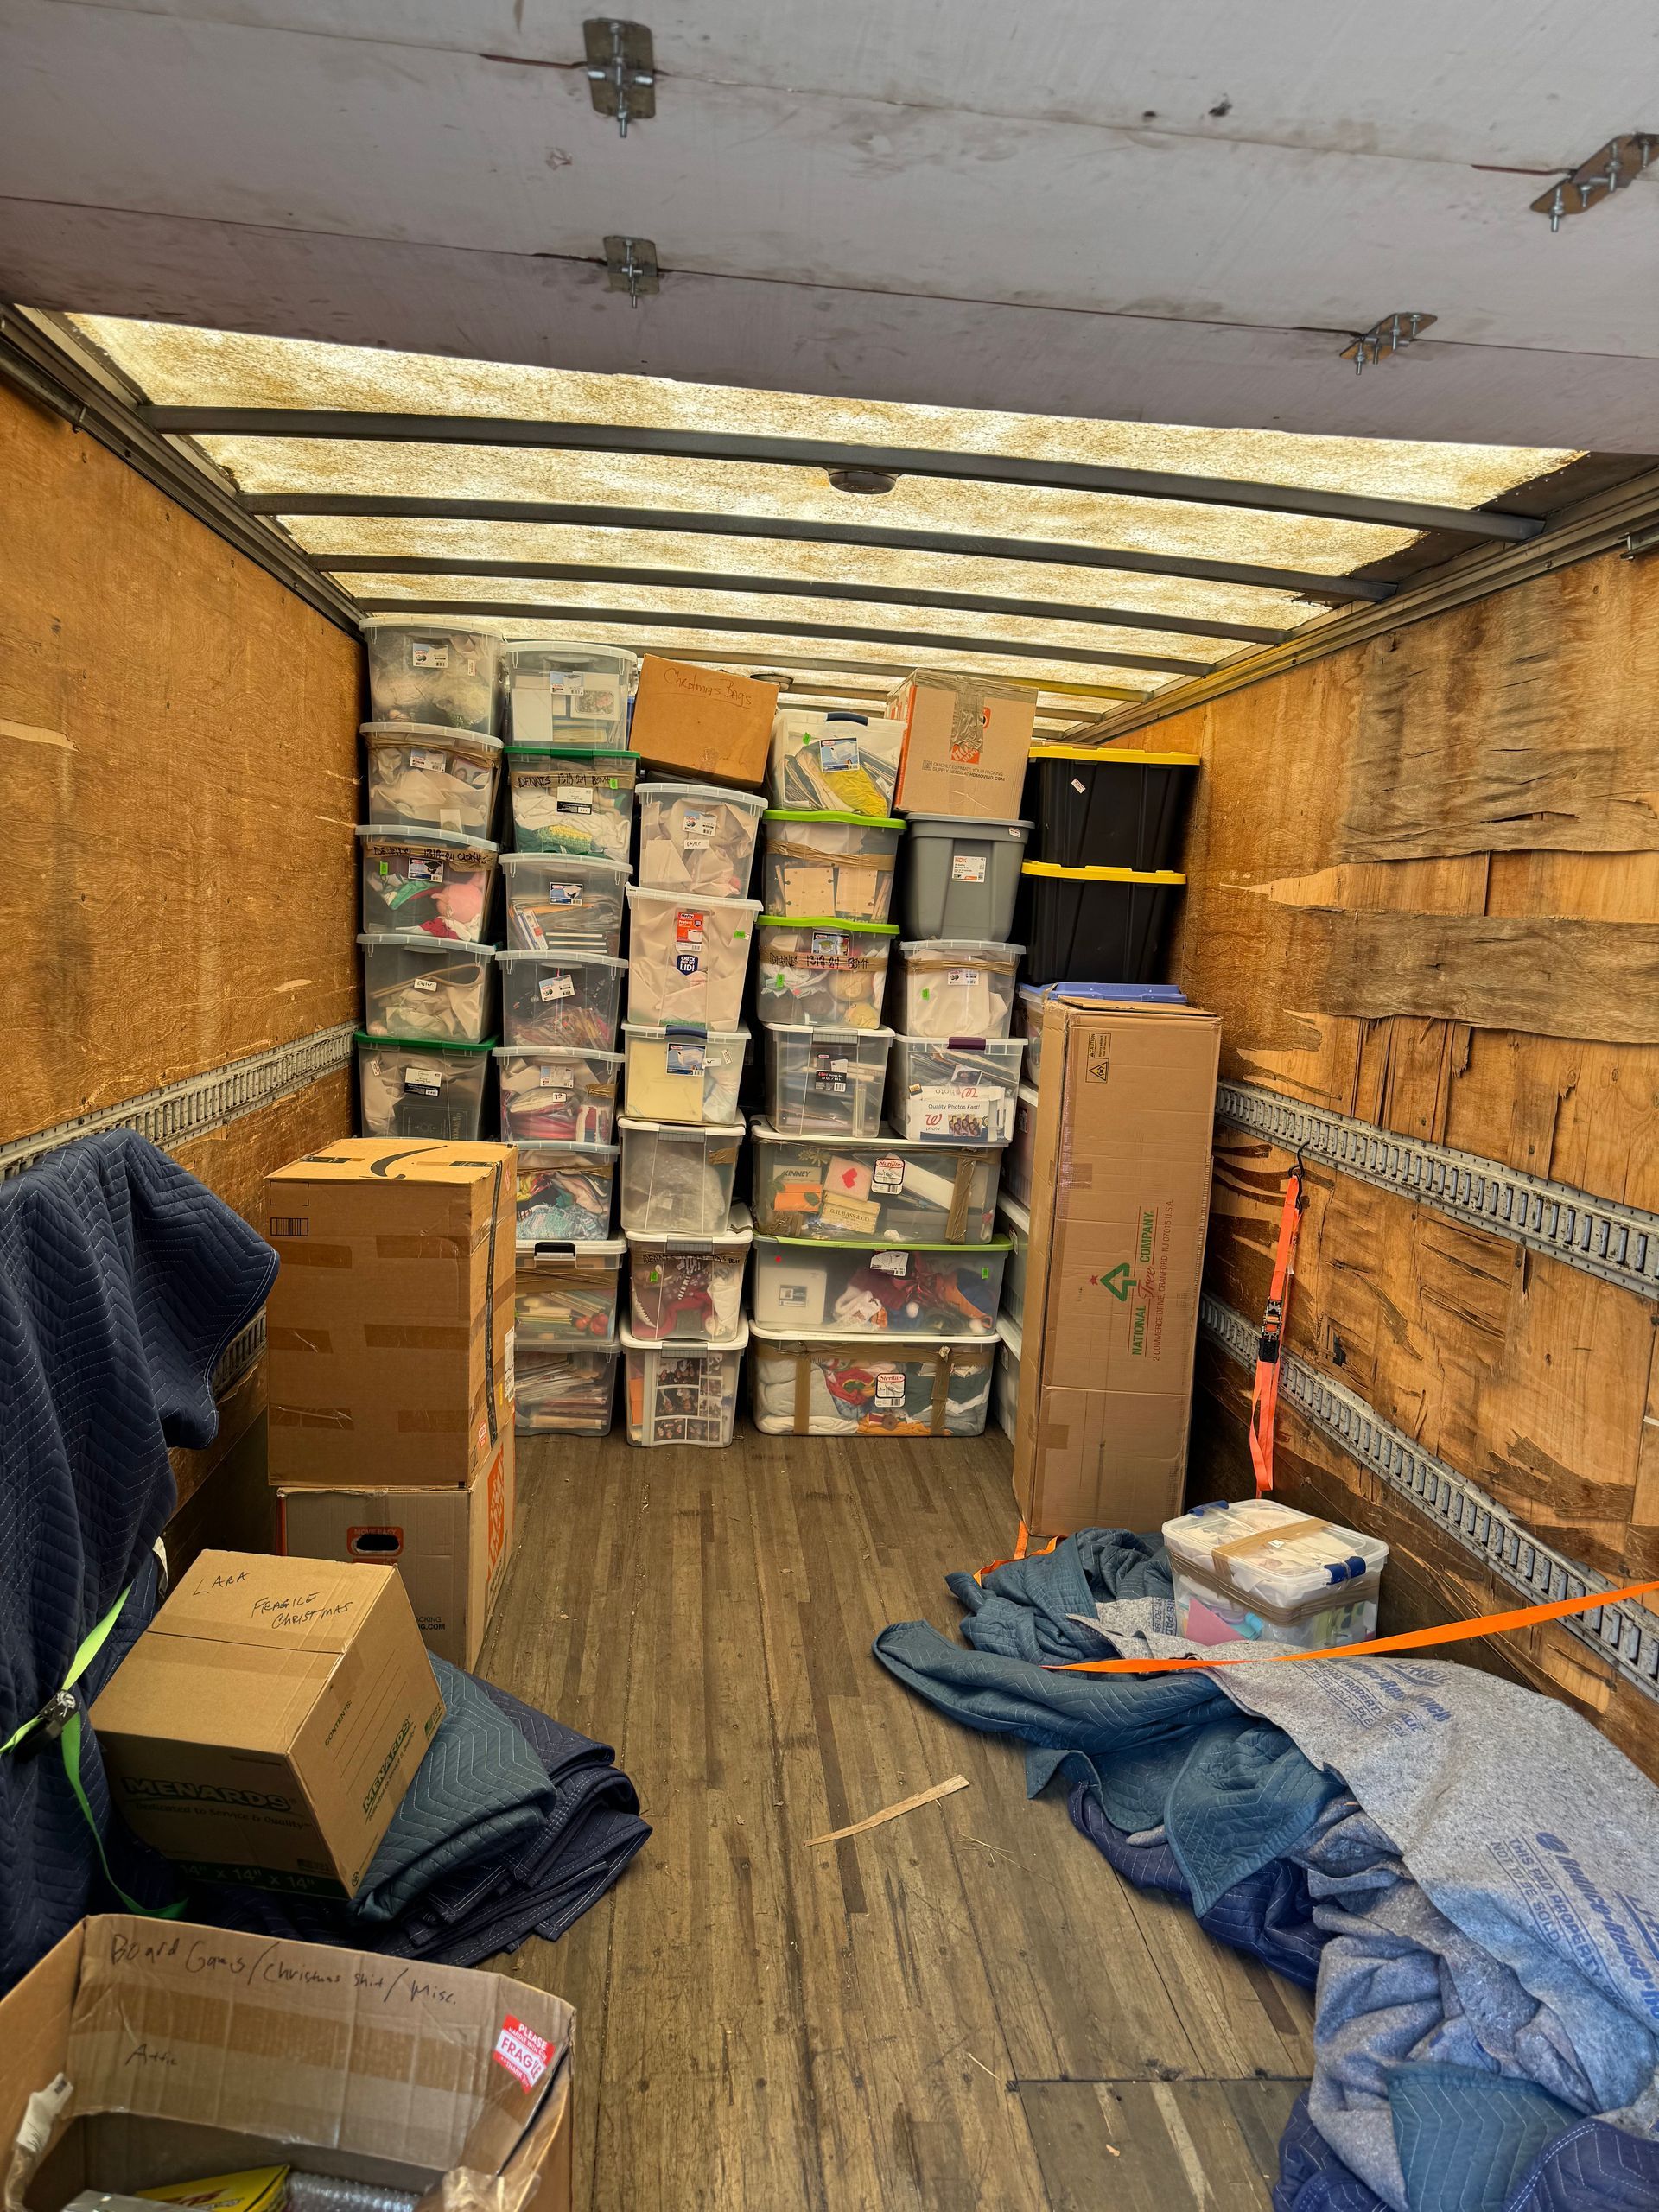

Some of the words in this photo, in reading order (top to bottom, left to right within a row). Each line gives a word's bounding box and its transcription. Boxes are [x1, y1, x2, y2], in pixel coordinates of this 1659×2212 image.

[518, 776, 551, 788] DENNIS
[783, 1169, 810, 1178] KINNEY
[1164, 1243, 1169, 1252] NJ
[1137, 1266, 1156, 1300] Tree
[1159, 1254, 1168, 1291] CRANFORD,
[1156, 1294, 1165, 1314] DRIVE,
[1132, 1305, 1147, 1355] NATIONAL
[1153, 1316, 1163, 1355] COMMERCE
[193, 1571, 251, 1596] LARA
[251, 1592, 322, 1618] FRAGILE
[1324, 1668, 1342, 1682] PAD
[1341, 1678, 1383, 1716] PROPERTY
[1330, 1685, 1351, 1703] SOLD
[324, 1700, 353, 1747] CONTENTS:
[136, 1802, 190, 1814] Dedicated
[194, 1807, 207, 1815] to
[209, 1808, 249, 1821] Service
[264, 1816, 304, 1830] Quality
[1491, 1840, 1512, 1864] NOT
[1510, 1865, 1524, 1879] TO
[1521, 1881, 1538, 1898] BE
[1533, 1901, 1560, 1942] SOLD
[1510, 1838, 1535, 1866] THIS
[1529, 1867, 1554, 1891] PAD
[1548, 1894, 1603, 1977] PROPERTY
[110, 1933, 180, 1966] Board
[518, 2023, 548, 2050] PLEASE
